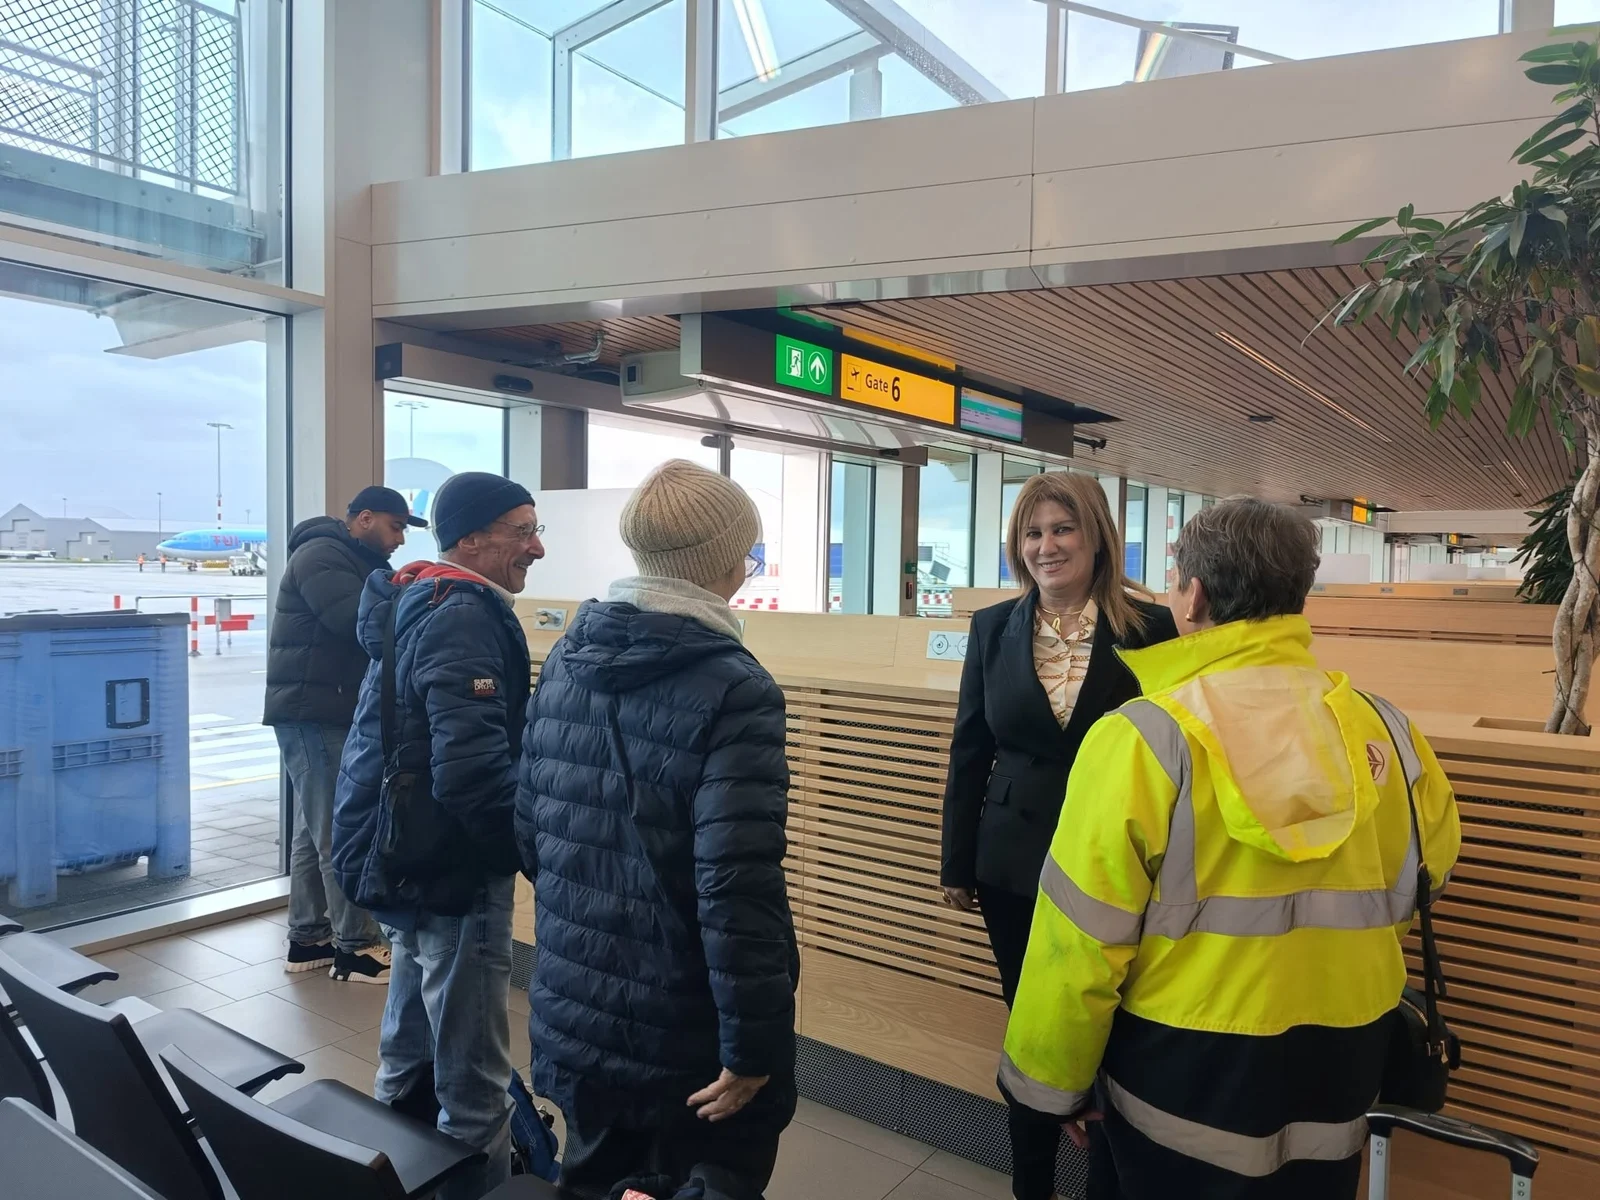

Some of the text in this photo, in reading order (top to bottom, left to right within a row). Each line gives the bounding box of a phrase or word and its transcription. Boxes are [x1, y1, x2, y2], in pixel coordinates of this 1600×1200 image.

[866, 374, 901, 402] Gate 6
[212, 535, 239, 546] TUI
